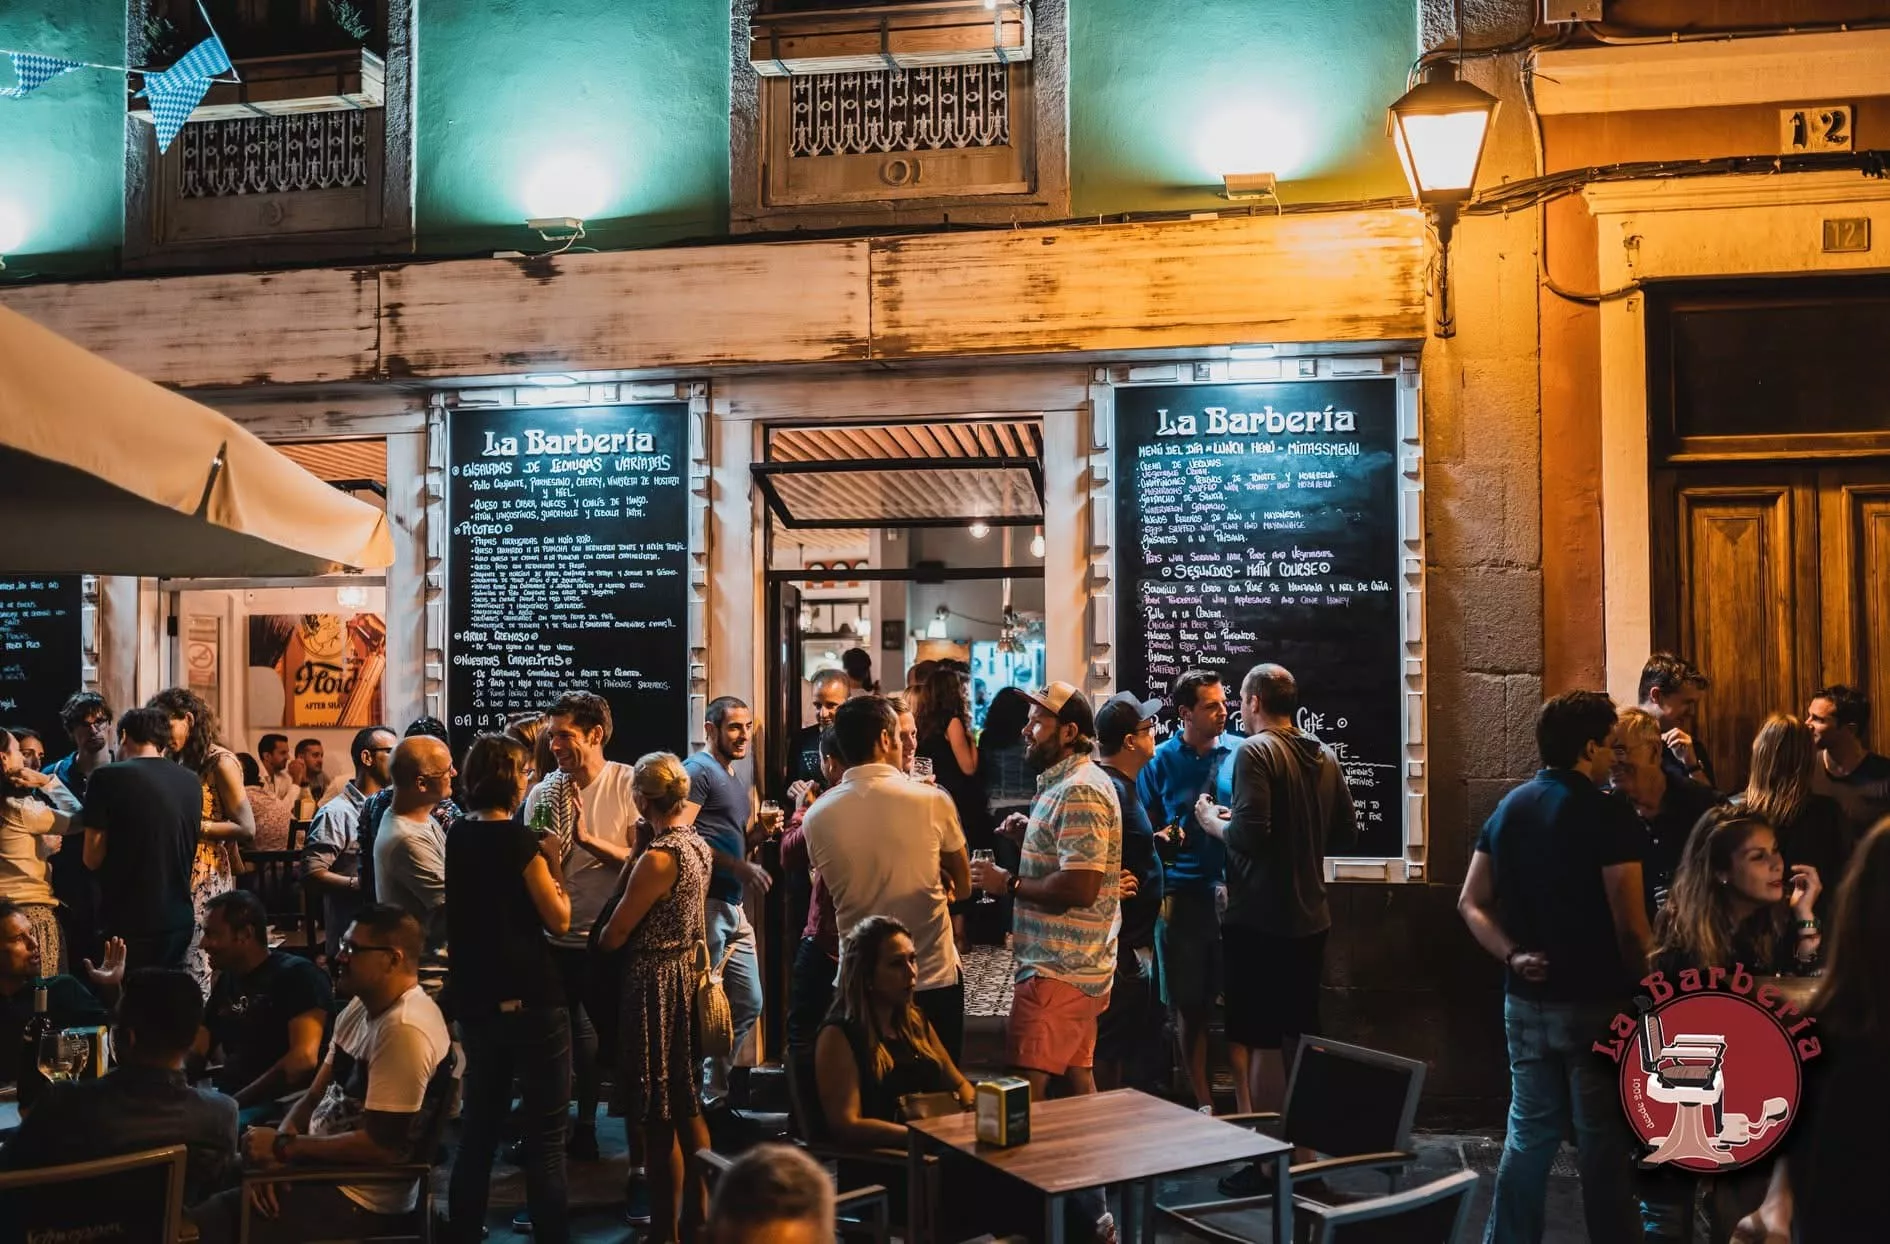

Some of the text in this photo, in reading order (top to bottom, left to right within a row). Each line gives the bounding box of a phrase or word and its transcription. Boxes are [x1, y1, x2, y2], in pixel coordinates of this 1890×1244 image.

[1790, 111, 1850, 148] 12
[1832, 222, 1857, 248] 12
[1156, 405, 1356, 435] La Barbería
[482, 428, 654, 456] La Barbería
[463, 462, 512, 476] ENSALADAS
[523, 462, 540, 473] DE
[459, 521, 502, 535] PICOTEO
[1247, 561, 1272, 577] MAIN
[1279, 562, 1318, 577] COURSE
[478, 714, 488, 726] LA
